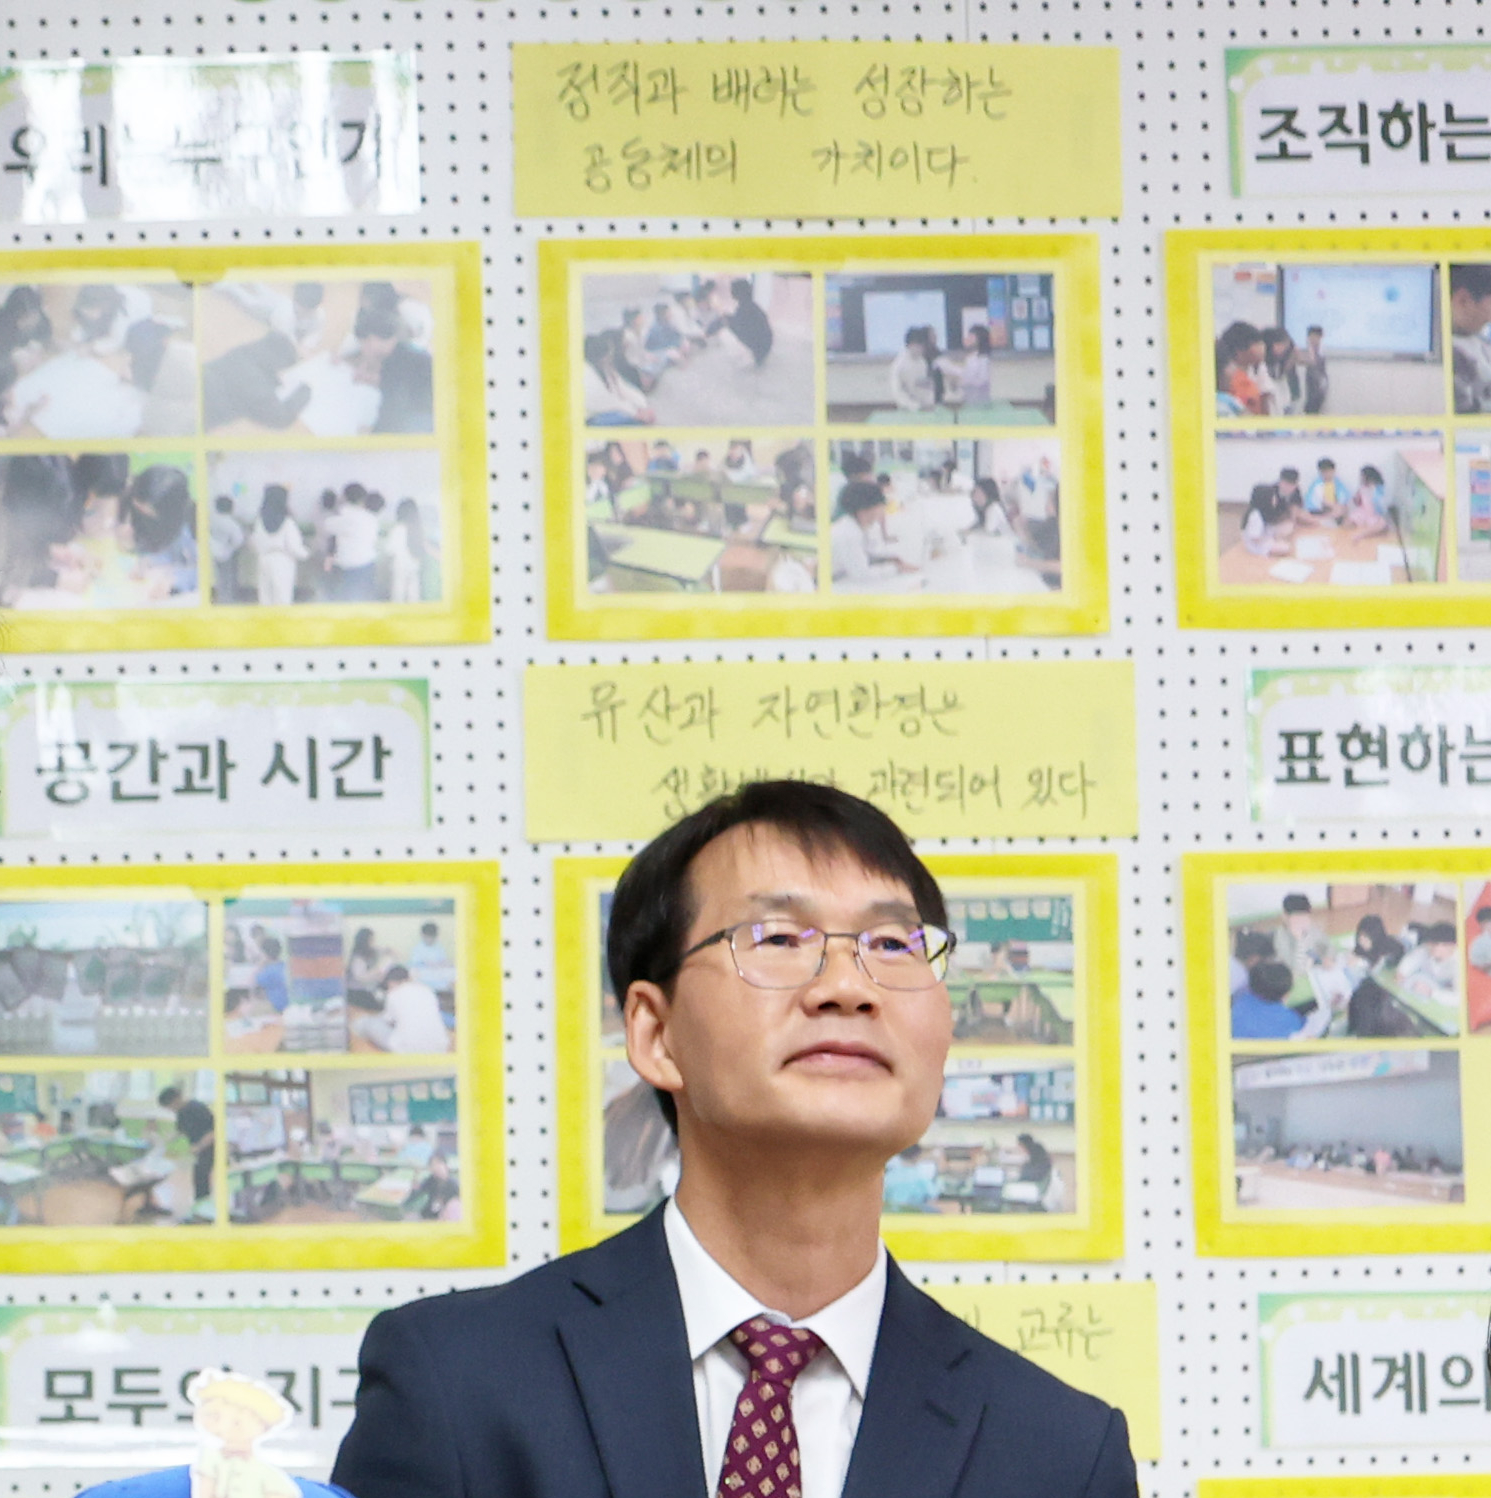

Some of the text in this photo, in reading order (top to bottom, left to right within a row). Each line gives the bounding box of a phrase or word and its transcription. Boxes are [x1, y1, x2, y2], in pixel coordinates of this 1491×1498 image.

[557, 60, 689, 122] 정직과
[854, 61, 1014, 121] 성장하는
[1255, 99, 1491, 165] 조직하는
[580, 679, 720, 745] 유산과
[36, 734, 393, 806] 공간과 시간
[1026, 759, 1098, 819] 있다
[1303, 1350, 1491, 1415] 세계의
